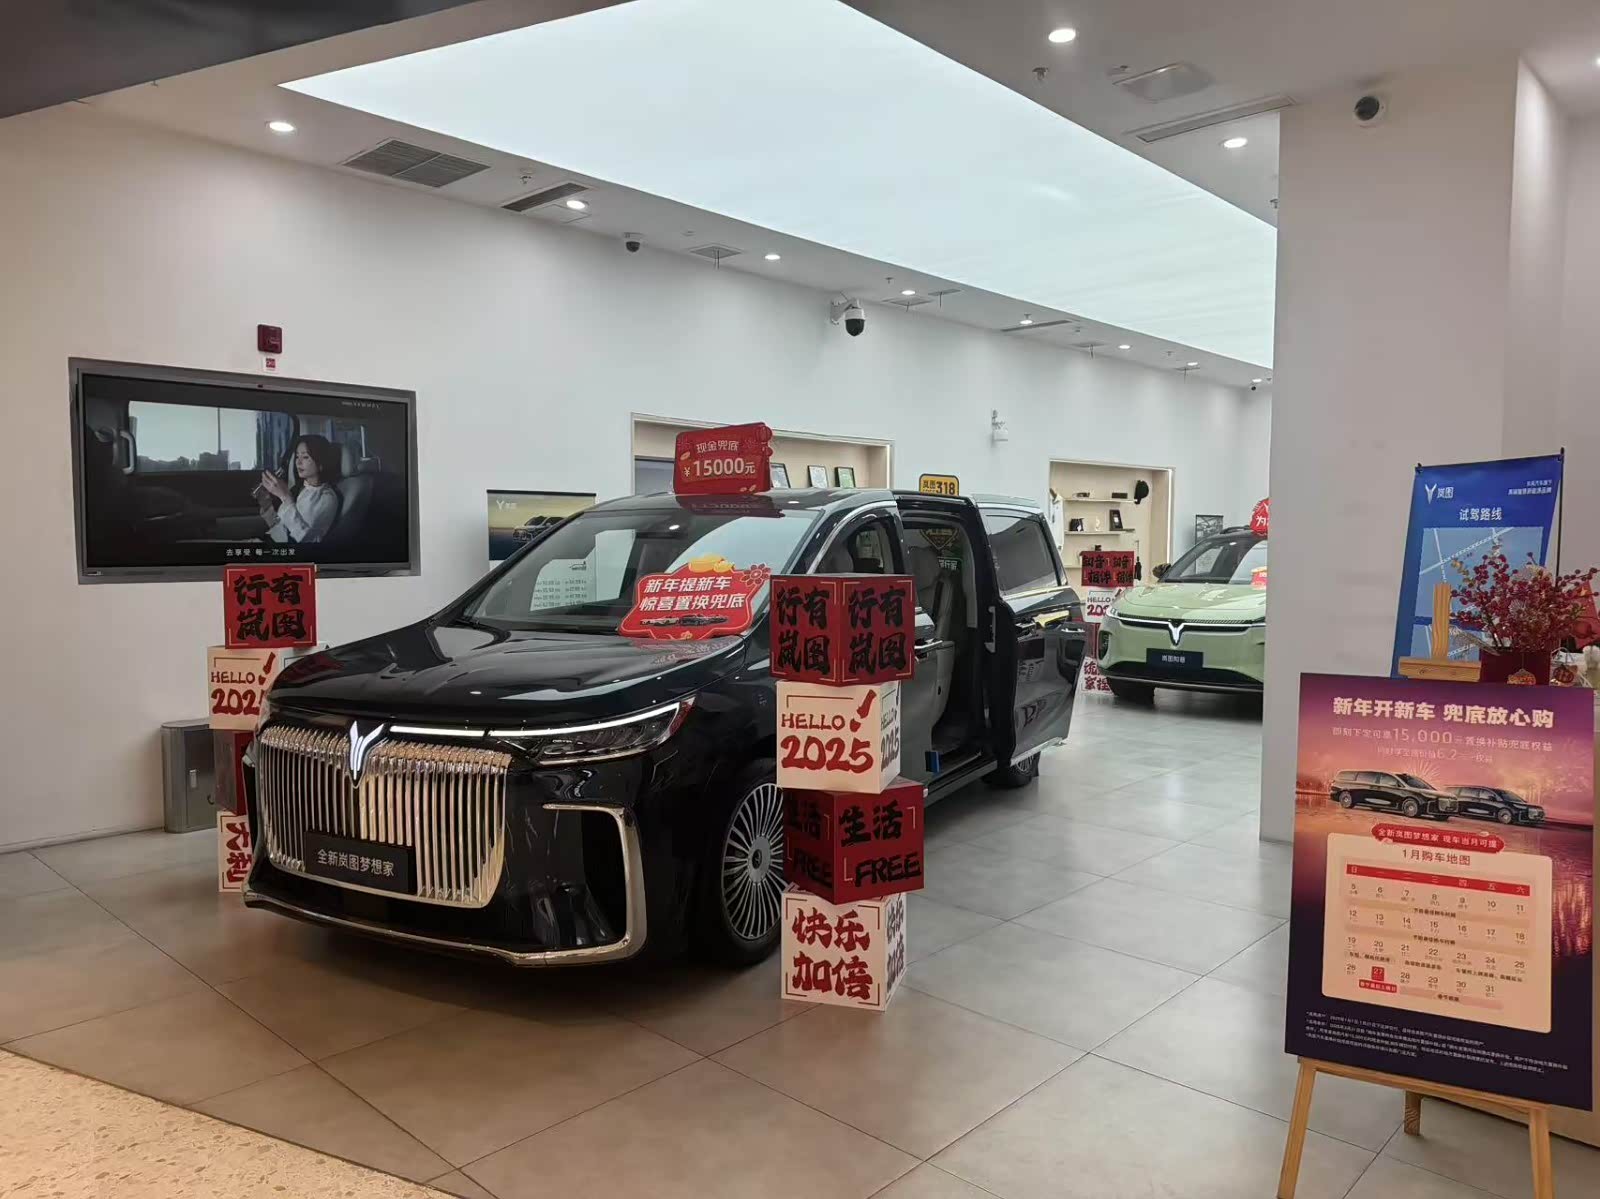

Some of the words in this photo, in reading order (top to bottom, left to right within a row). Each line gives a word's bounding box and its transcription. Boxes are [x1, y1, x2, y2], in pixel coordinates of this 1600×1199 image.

[696, 440, 739, 453] 现金兜底
[1437, 486, 1454, 499] 岚图
[1459, 507, 1503, 521] 试驾路线
[234, 572, 304, 606] 行有
[644, 576, 733, 593] 新年提新车
[639, 593, 747, 612] 惊喜置换兜底
[776, 586, 830, 629] 行有
[848, 586, 906, 629] 行有
[1333, 696, 1436, 720] 新年开新车
[1443, 703, 1554, 728] 兜底放心购
[780, 735, 874, 773] 2025
[839, 800, 903, 847] 生活
[1378, 828, 1439, 842] 全新岚图梦想家
[1443, 834, 1498, 849] 现车当月可提
[317, 848, 395, 877] 全新岚图梦想家
[855, 852, 922, 887] FREE
[1402, 848, 1471, 866] 1月购车地图
[791, 907, 870, 952] 快乐
[791, 951, 873, 1000] 加倍
